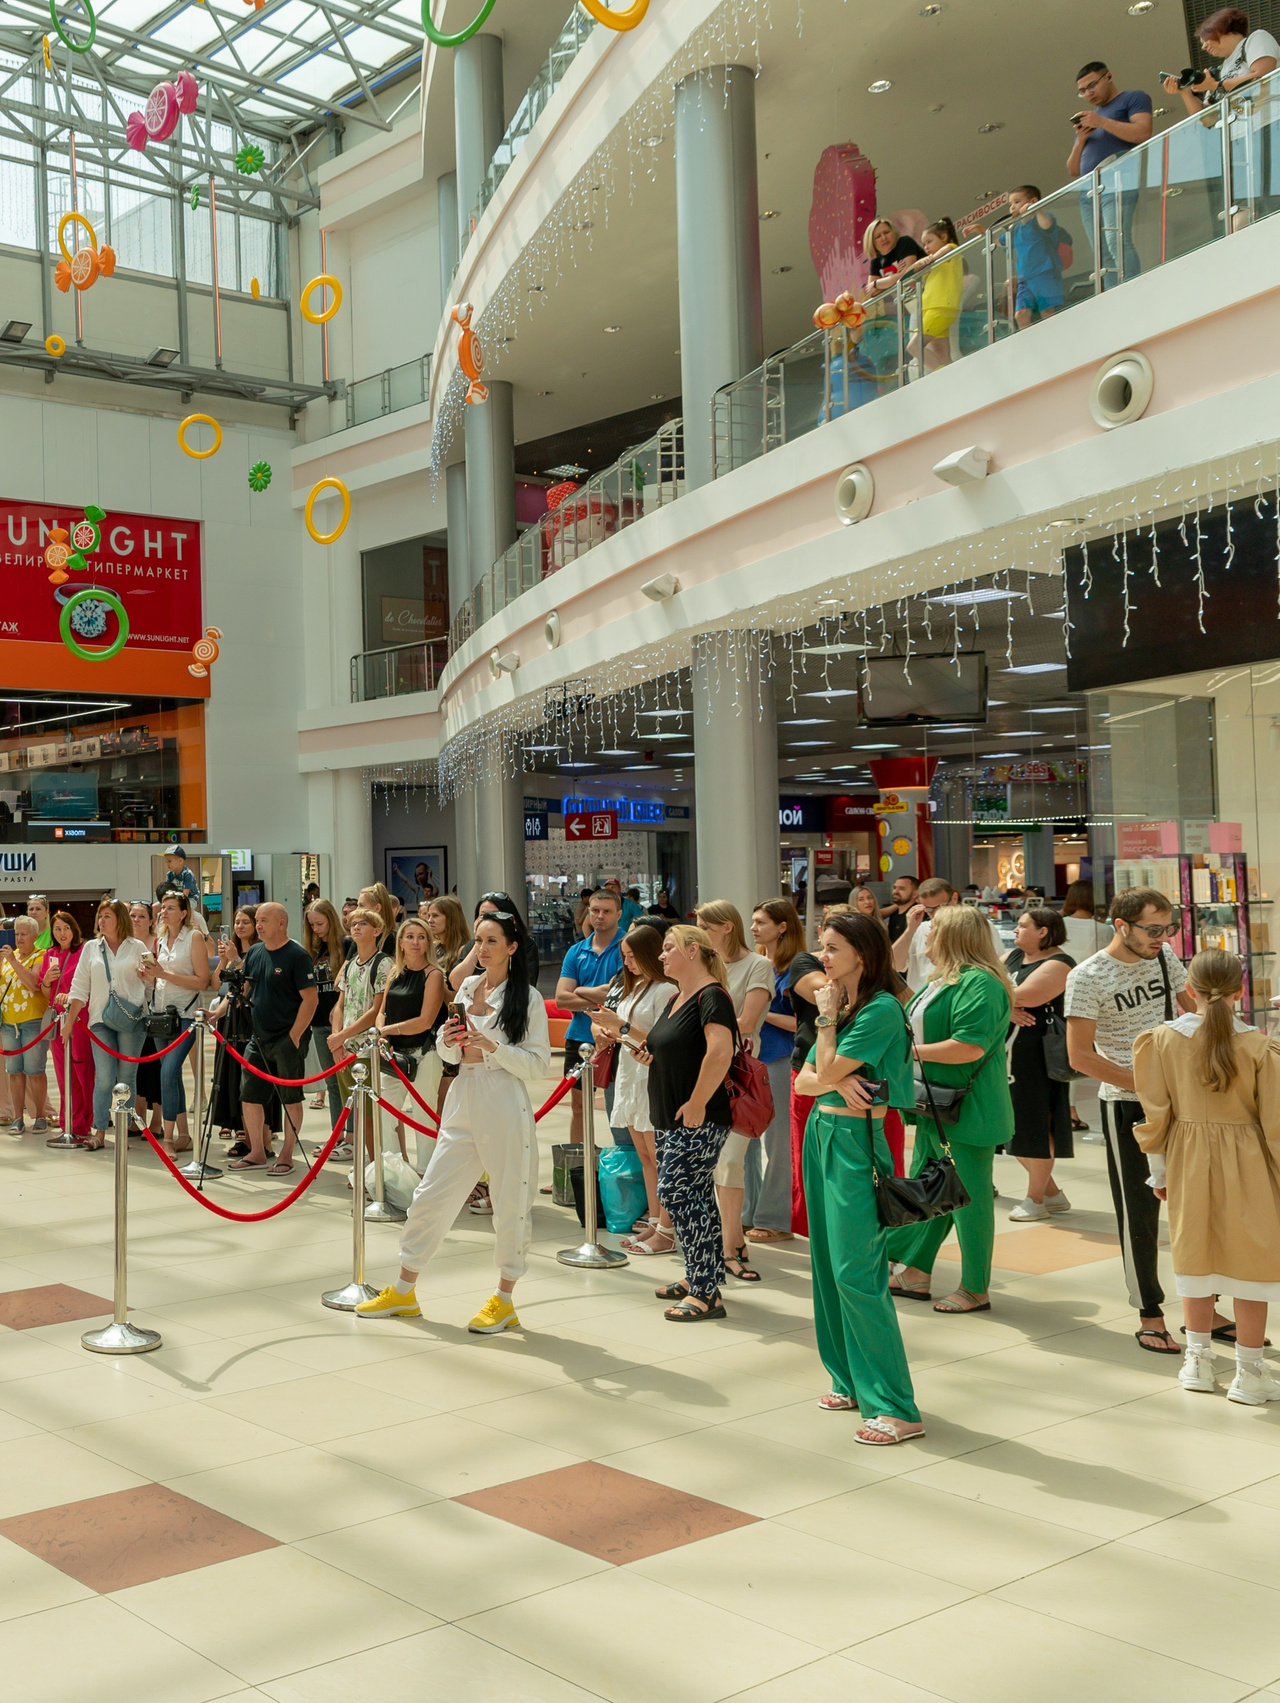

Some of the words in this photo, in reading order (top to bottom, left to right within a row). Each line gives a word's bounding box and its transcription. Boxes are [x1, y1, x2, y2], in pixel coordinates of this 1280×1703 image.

[955, 194, 1007, 230] РАСИВОСБС
[86, 560, 189, 581] ГИПЕРМАРКЕТ
[126, 633, 190, 644] WWW.SUNLIGHT.NET
[1026, 764, 1047, 774] SBS
[64, 829, 86, 837] xiaomi
[1113, 978, 1167, 1012] NAS
